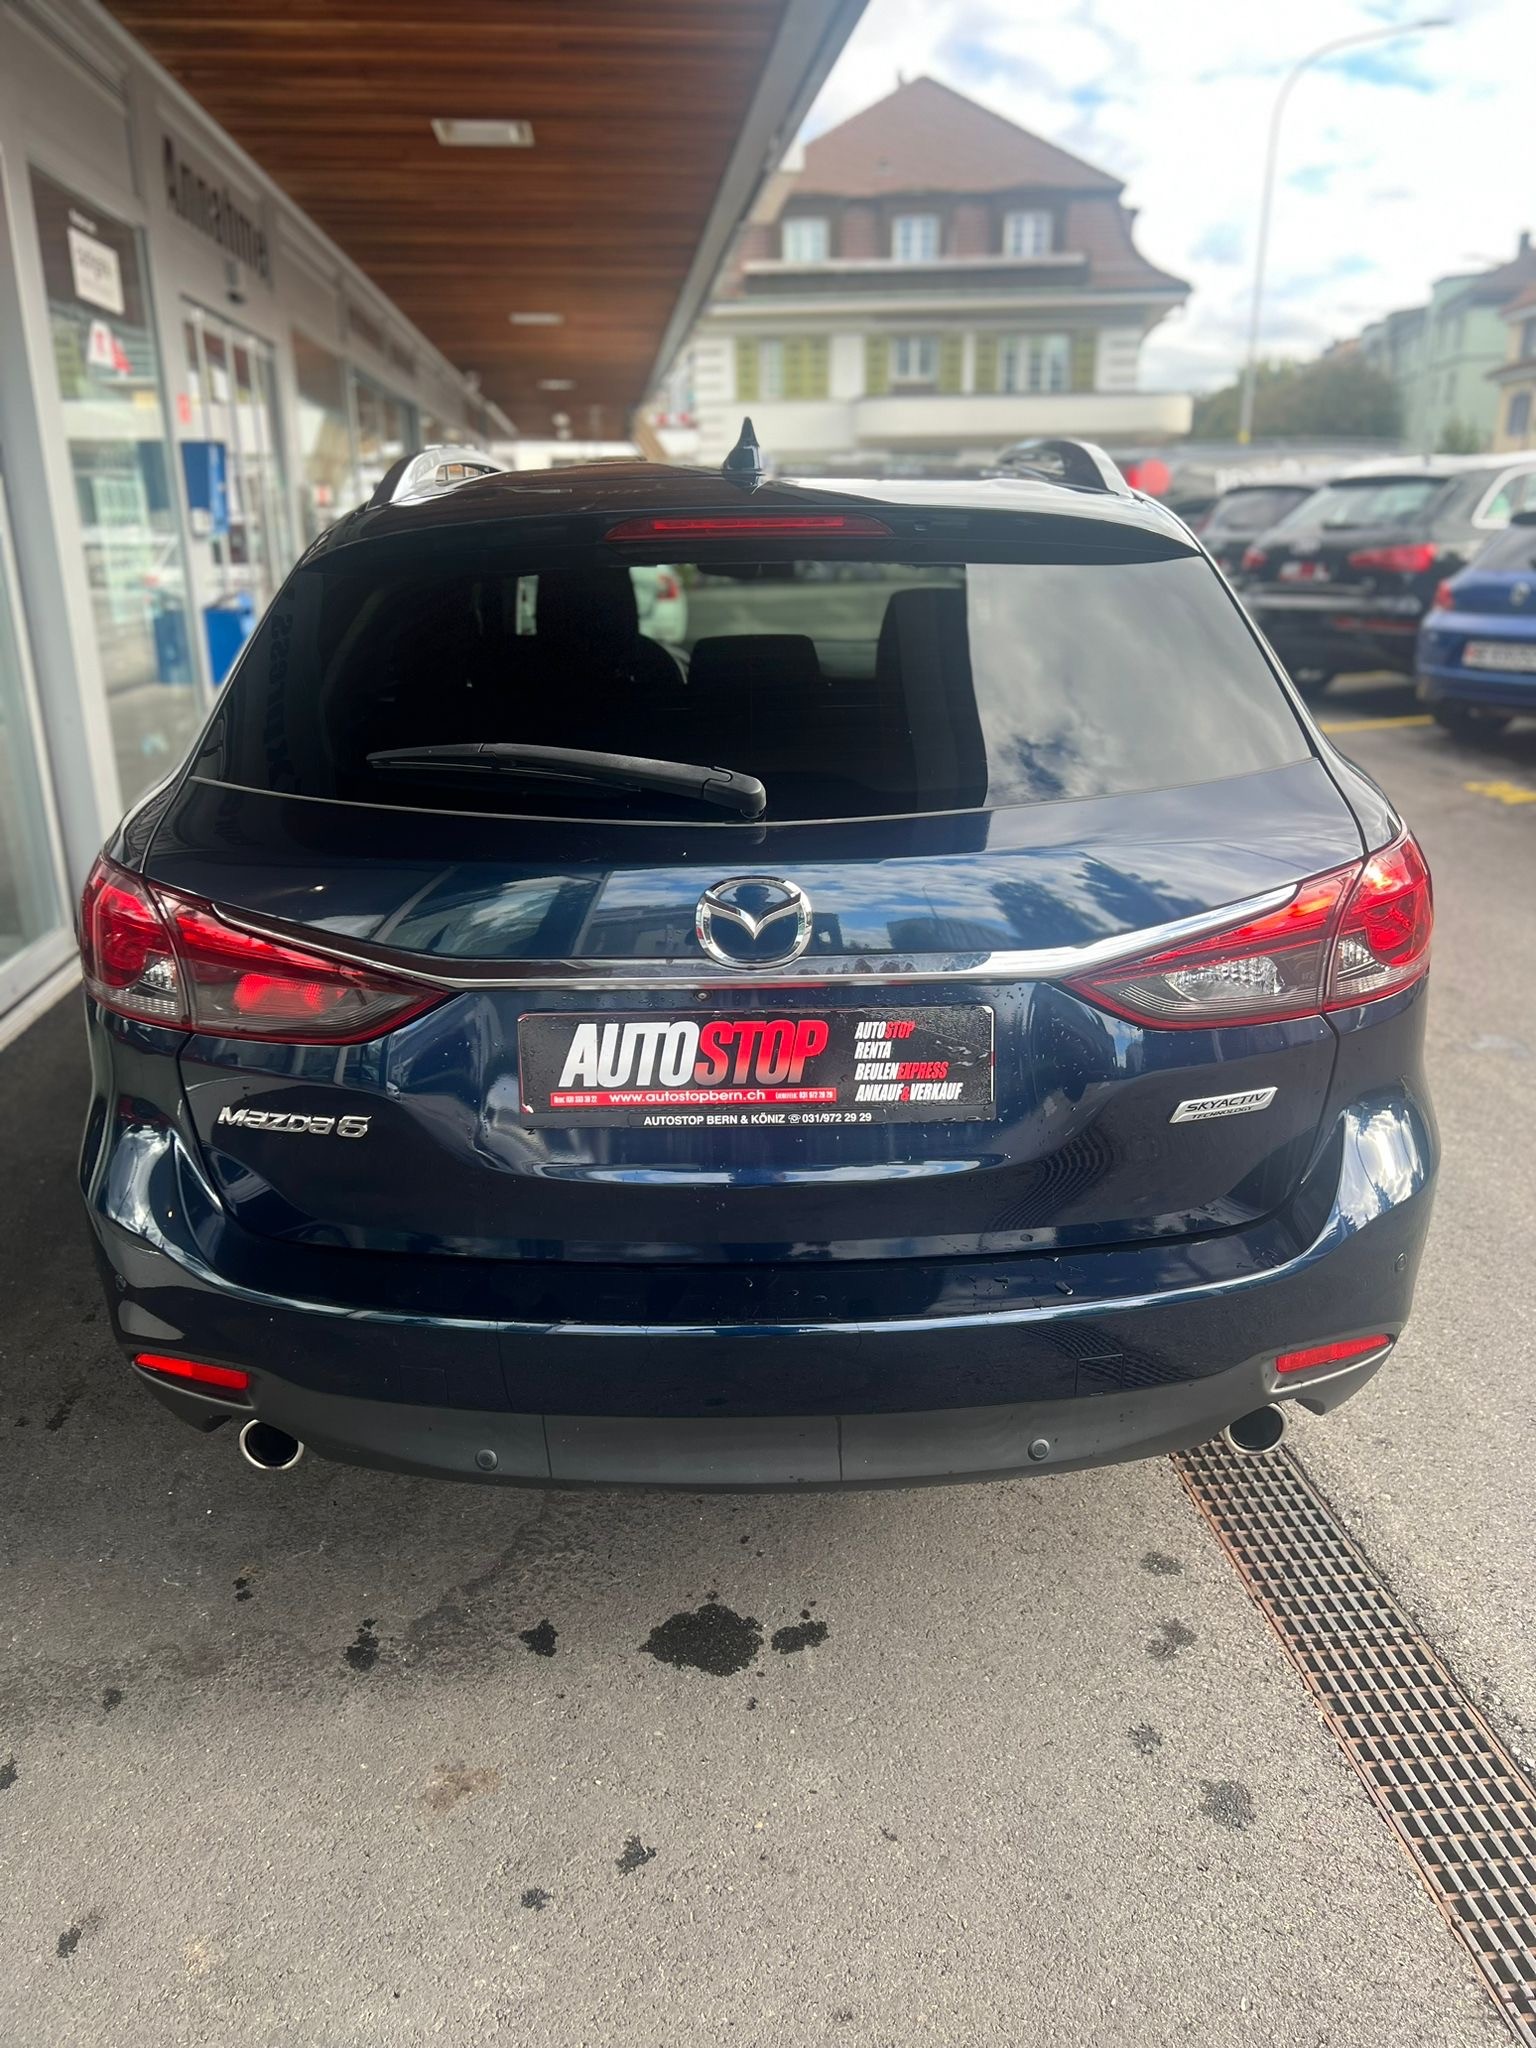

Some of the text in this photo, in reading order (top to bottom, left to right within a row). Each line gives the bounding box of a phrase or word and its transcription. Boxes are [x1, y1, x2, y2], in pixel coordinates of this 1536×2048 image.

[854, 1021, 916, 1039] AUTOSTOP
[558, 1019, 829, 1088] AUTOSTOP
[854, 1041, 892, 1059] RENTA
[854, 1061, 949, 1080] BEULENEXPRESS
[609, 1090, 766, 1103] www.autostopbern.ch
[855, 1082, 963, 1102] ANKAUF&VERKAUF
[1184, 1092, 1267, 1113] SKYACTIV
[644, 1112, 872, 1126] AUTOSTOP BERN & KÖNIZ 031/972 29 29
[1191, 1105, 1254, 1120] TECHNOLOGY
